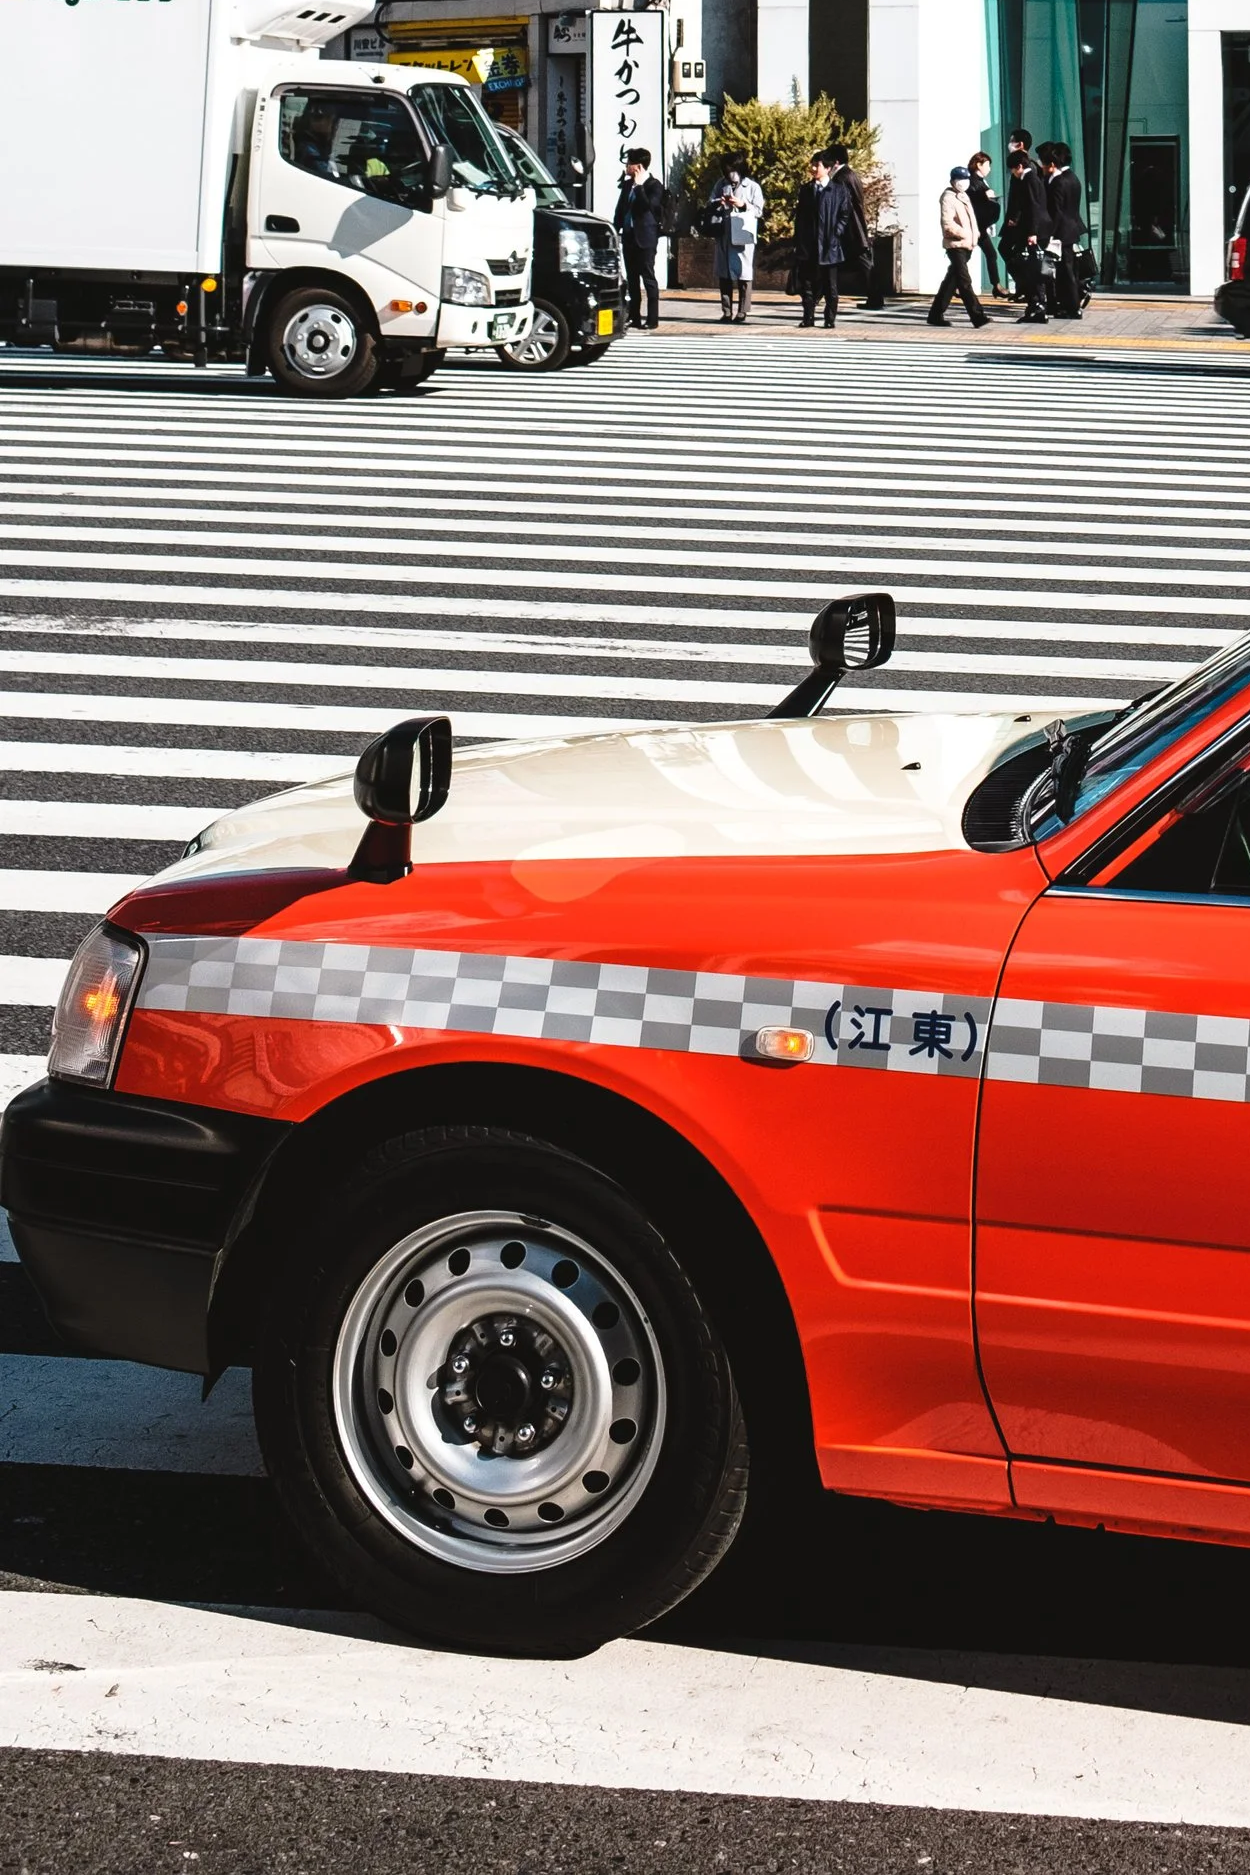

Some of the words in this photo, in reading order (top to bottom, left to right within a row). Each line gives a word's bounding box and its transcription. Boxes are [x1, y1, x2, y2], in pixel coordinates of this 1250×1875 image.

[611, 19, 644, 189] 牛かつもと
[825, 1000, 977, 1062] (江東)
